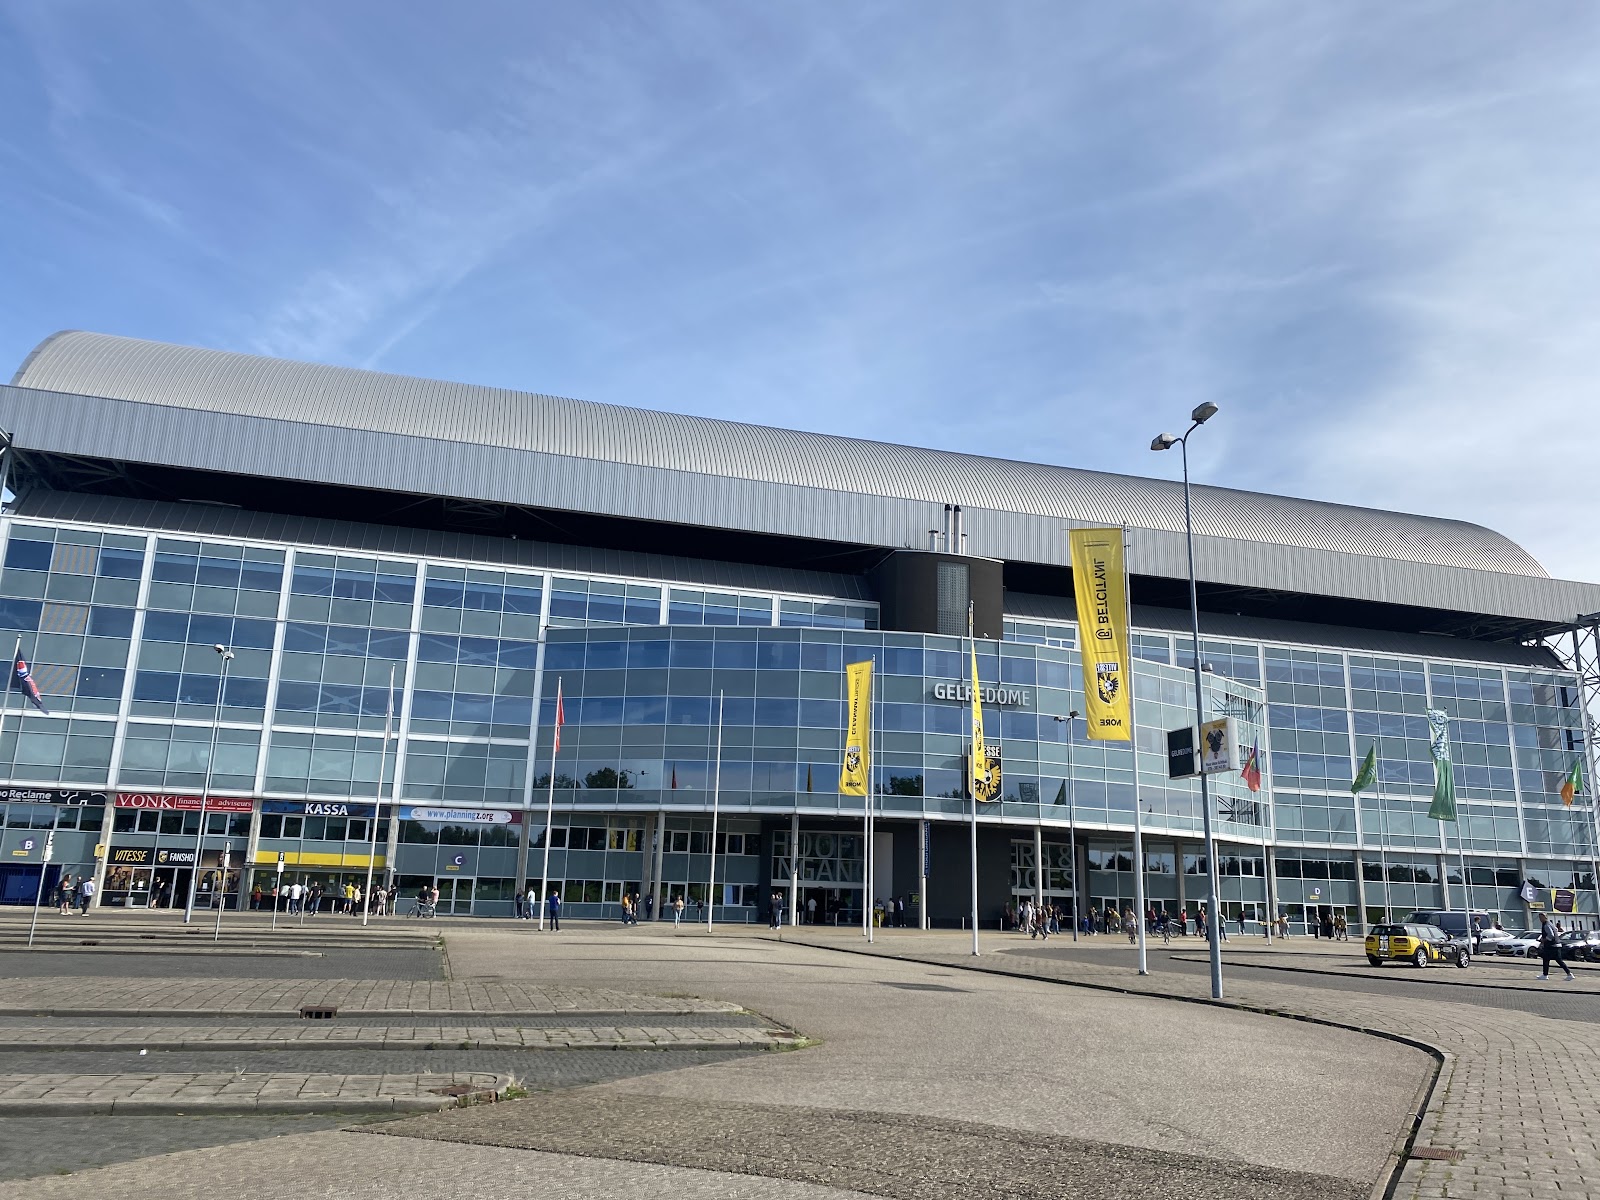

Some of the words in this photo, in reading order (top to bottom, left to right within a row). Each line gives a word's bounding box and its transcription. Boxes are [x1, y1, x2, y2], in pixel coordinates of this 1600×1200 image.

[8, 789, 52, 800] Reclame
[118, 794, 175, 809] VONK
[217, 799, 252, 807] adviseurs
[304, 802, 349, 816] KASSA
[427, 810, 494, 821] www.planningz.org
[24, 841, 33, 849] B
[114, 849, 148, 862] VITESSE
[169, 852, 195, 863] FANSHO
[454, 855, 463, 865] C
[1314, 887, 1321, 895] D
[1526, 887, 1534, 899] E
